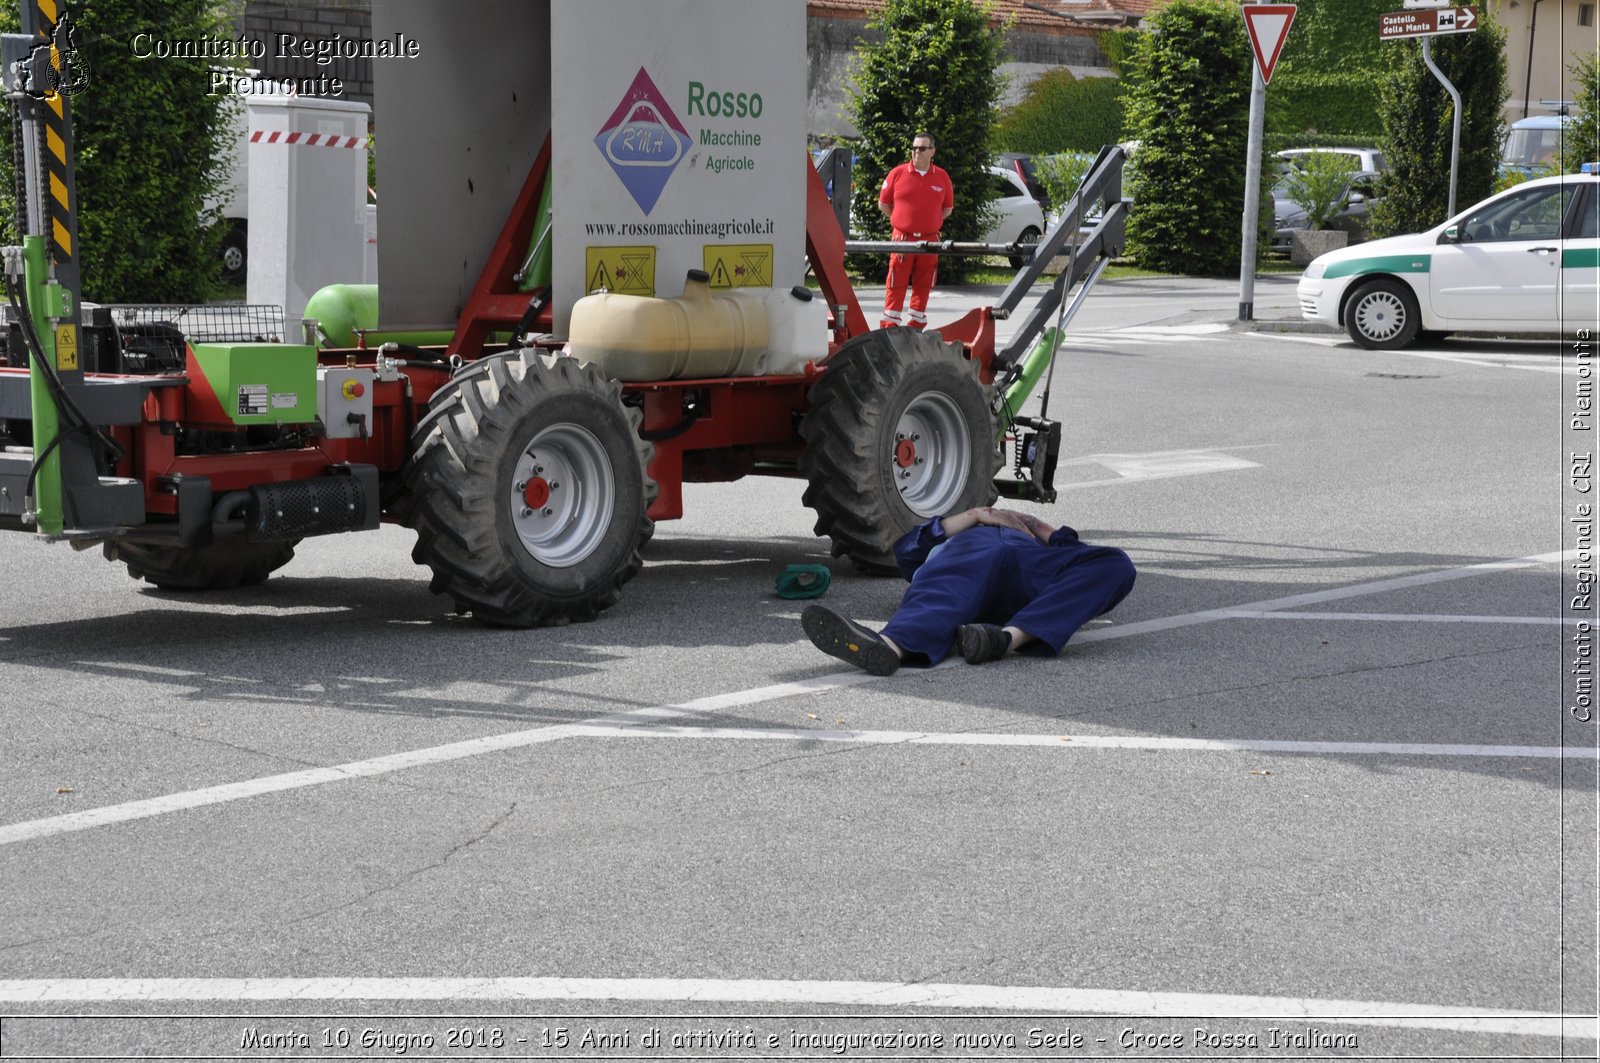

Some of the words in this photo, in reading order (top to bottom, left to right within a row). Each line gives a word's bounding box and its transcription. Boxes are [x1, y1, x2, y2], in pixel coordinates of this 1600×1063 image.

[1383, 15, 1416, 25] Castello
[1383, 25, 1403, 34] della
[1406, 23, 1430, 32] Manta
[687, 81, 763, 119] Rosso
[621, 127, 666, 153] RMA
[700, 129, 762, 146] Macchine
[706, 155, 755, 174] Agricole
[585, 218, 775, 239] www.rossomacchineagricole.it
